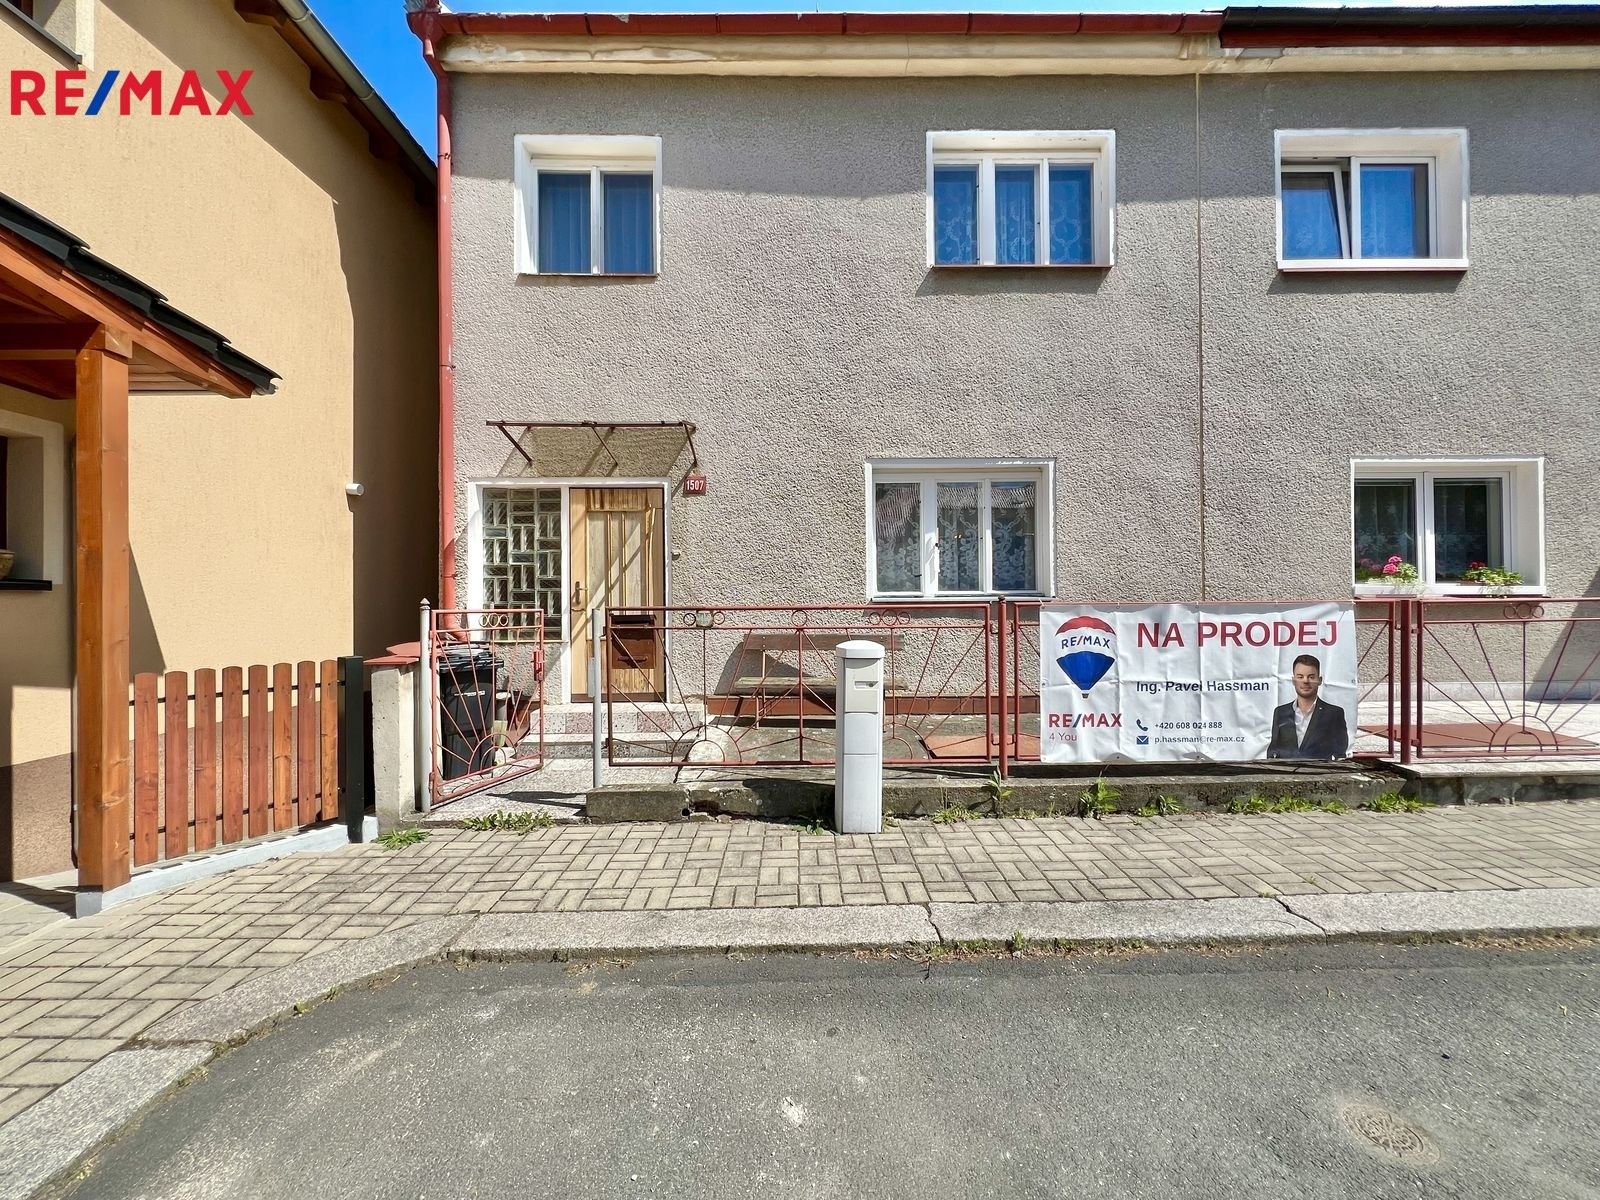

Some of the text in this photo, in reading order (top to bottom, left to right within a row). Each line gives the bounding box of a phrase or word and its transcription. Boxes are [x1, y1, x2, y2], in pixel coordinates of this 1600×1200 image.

[686, 480, 704, 491] 1507
[1137, 620, 1338, 648] NA PRODEJ
[1061, 635, 1111, 650] RE/MAX
[1136, 680, 1270, 695] Ing. Pavel Hassman
[1048, 713, 1122, 728] RE/MAX
[1154, 721, 1223, 730] +420 608 024 888
[1048, 732, 1078, 741] 4 You
[1154, 735, 1246, 745] p.hassman@re-max.cz
